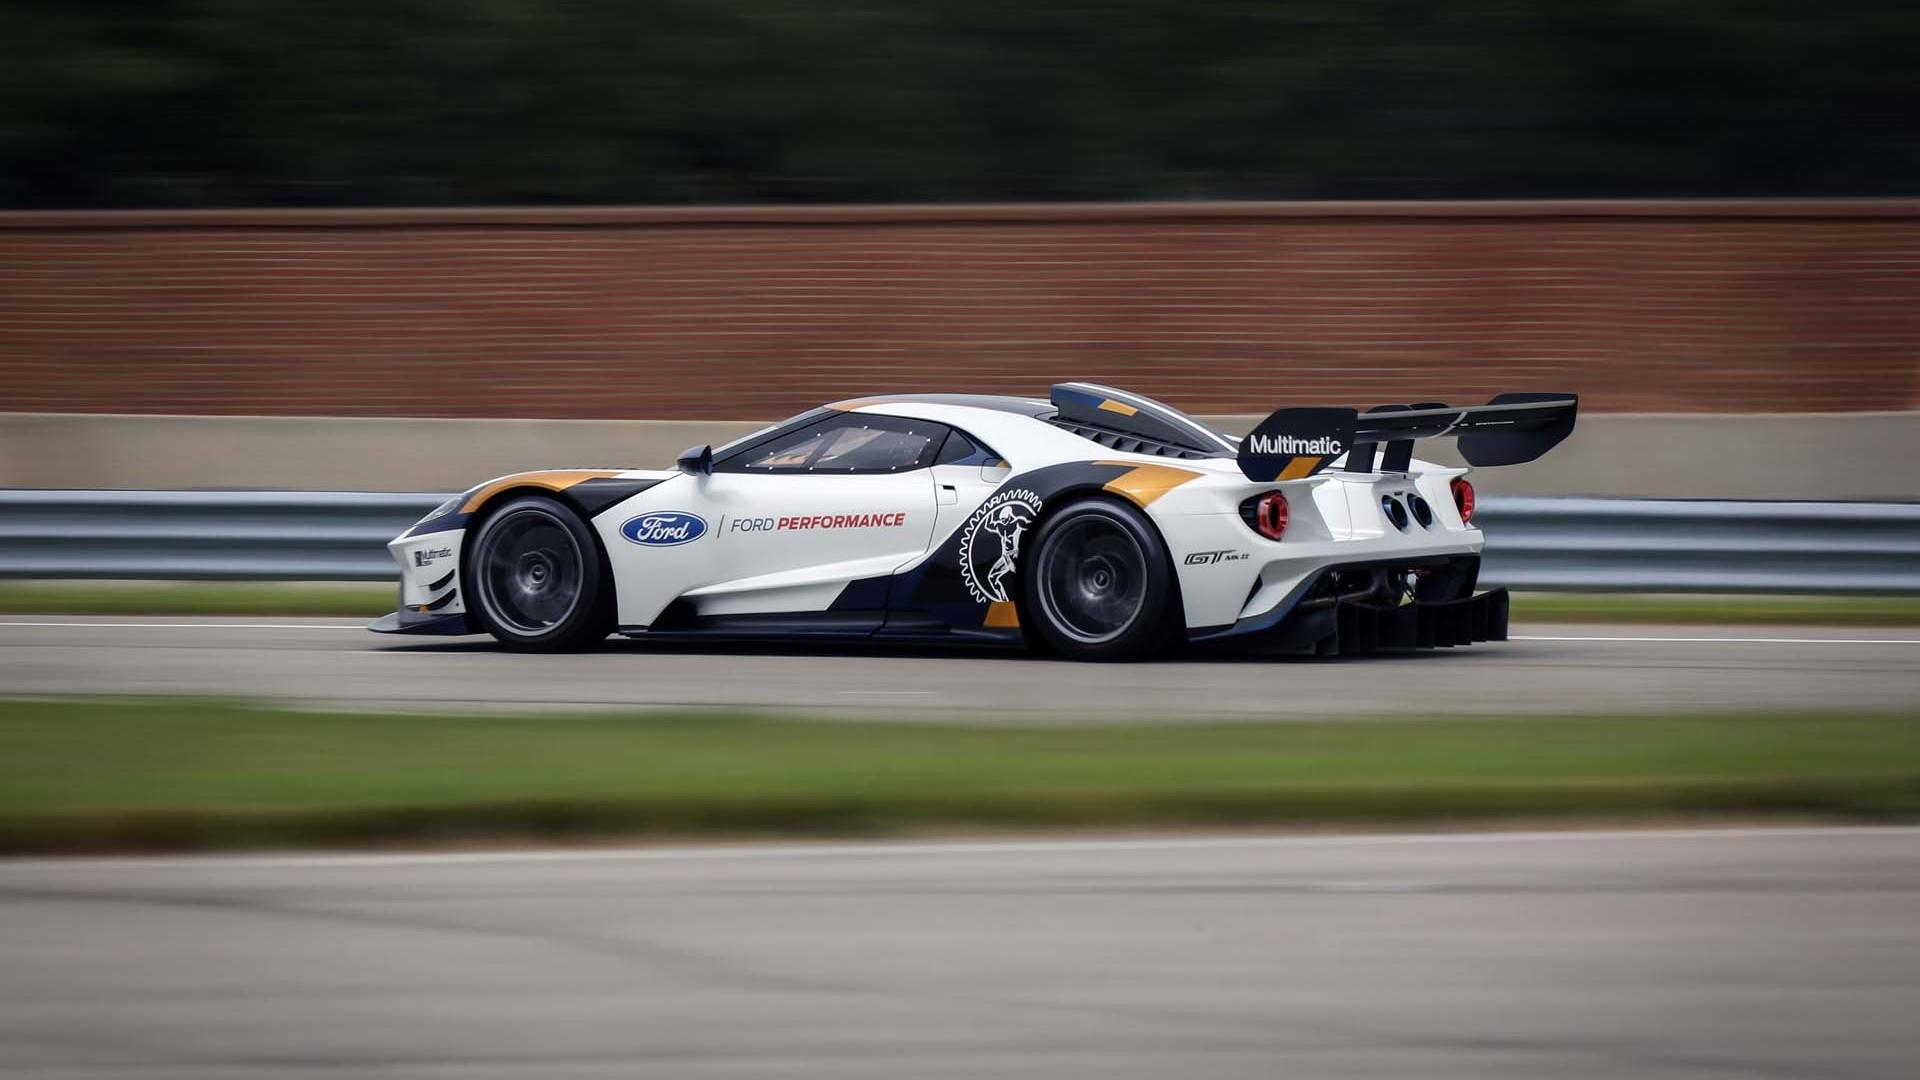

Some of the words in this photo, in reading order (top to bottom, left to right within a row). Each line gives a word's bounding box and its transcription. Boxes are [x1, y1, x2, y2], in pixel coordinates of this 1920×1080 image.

[1250, 434, 1341, 455] Multimatic
[637, 516, 690, 541] Ford
[731, 517, 775, 533] FORD
[777, 512, 906, 531] PERFORMANCE
[1184, 549, 1237, 565] GT
